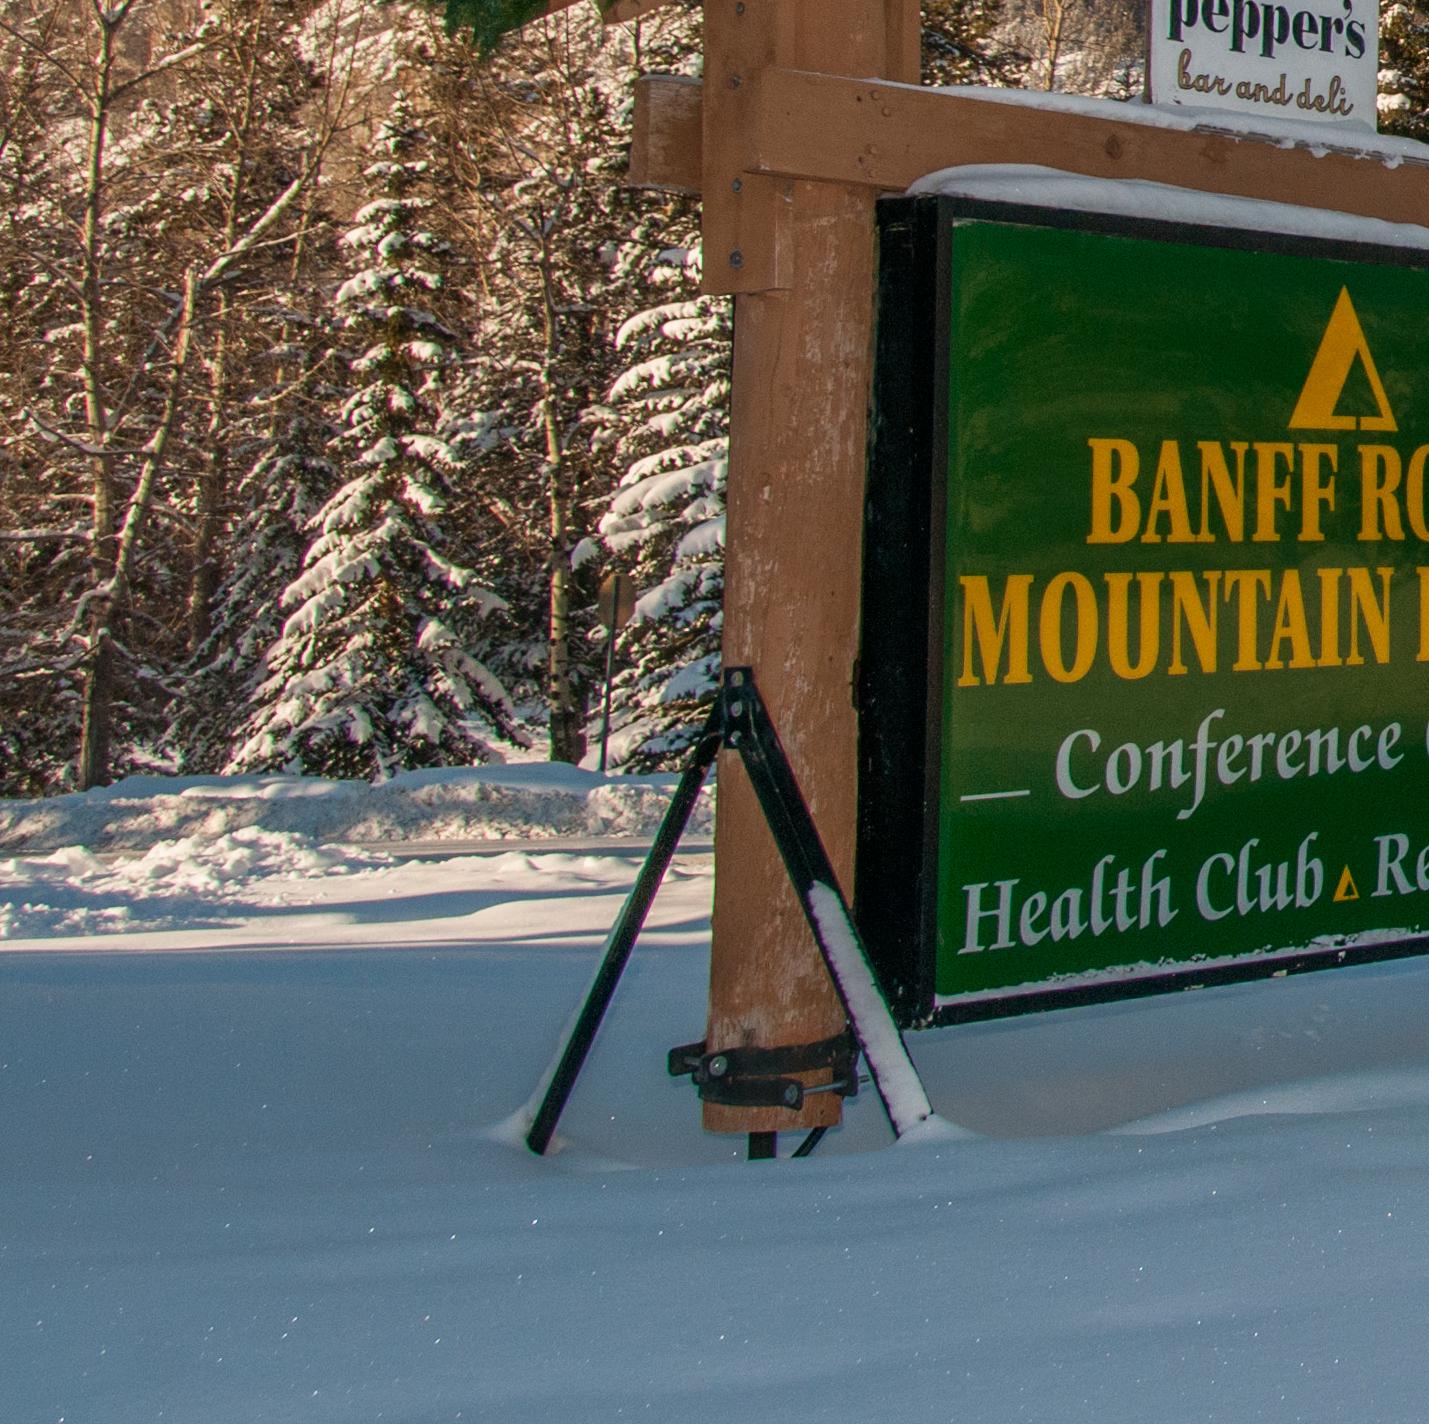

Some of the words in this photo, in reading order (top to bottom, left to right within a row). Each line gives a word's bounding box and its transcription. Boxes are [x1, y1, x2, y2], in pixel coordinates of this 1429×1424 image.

[1178, 48, 1232, 94] bar
[1236, 73, 1293, 105] and
[1296, 75, 1353, 114] deli
[1086, 438, 1339, 543] BANFF
[957, 566, 1395, 686] MOUNTAIN
[1055, 708, 1403, 819] Conference
[957, 848, 1177, 954] Health
[1195, 831, 1323, 919] Club
